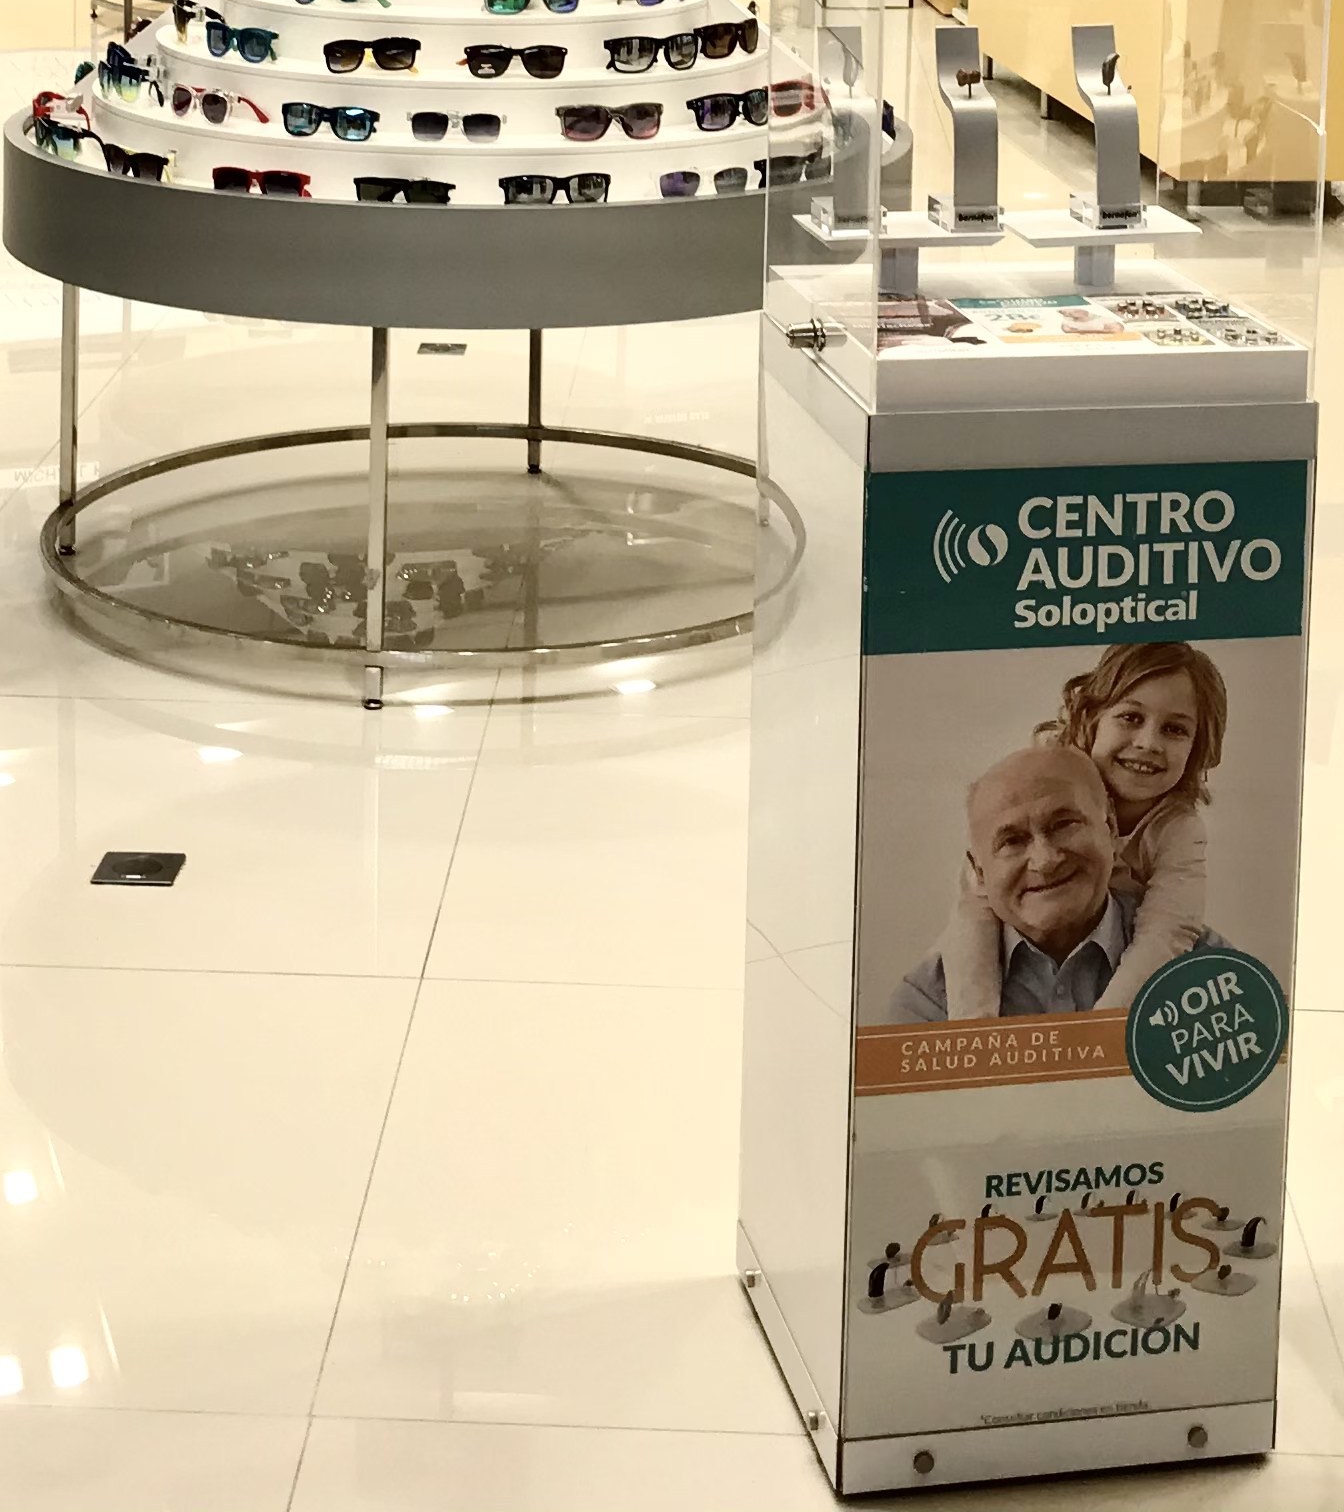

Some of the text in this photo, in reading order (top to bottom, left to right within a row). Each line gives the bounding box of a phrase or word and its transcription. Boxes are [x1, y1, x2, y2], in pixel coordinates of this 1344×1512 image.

[1017, 489, 1235, 540] CENTRO
[1016, 538, 1282, 592] AUDITIVO
[1014, 590, 1198, 633] Soloptical
[1180, 970, 1245, 1016] OIR
[901, 1030, 1059, 1056] CAMPAÑA DE
[1170, 1002, 1256, 1054] PARA
[900, 1044, 1106, 1073] SALUD AUDITIVA
[1164, 1030, 1265, 1087] VIVIR
[984, 1161, 1165, 1199] REVISAMOS
[910, 1196, 1221, 1304] GRATIS
[942, 1317, 1201, 1375] TU AUDICIÓN
